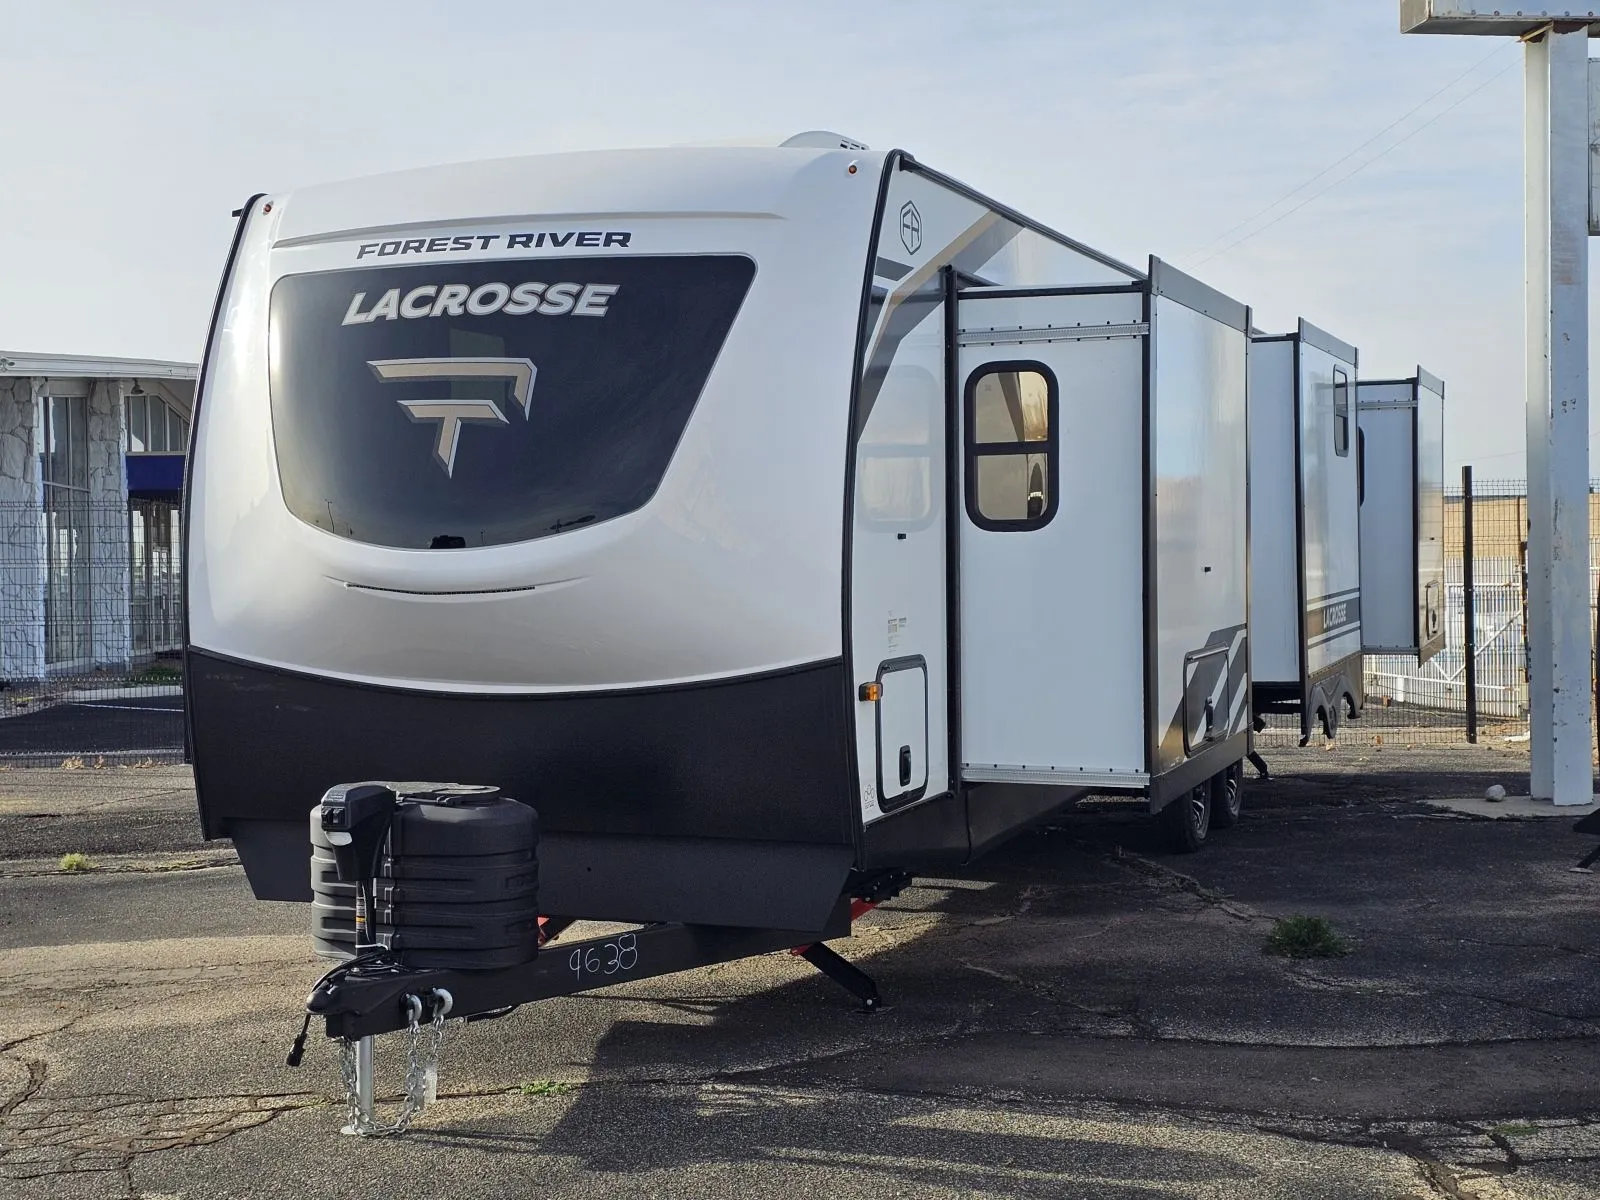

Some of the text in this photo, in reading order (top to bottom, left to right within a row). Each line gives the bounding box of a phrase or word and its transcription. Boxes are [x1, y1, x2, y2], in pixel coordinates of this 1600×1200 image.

[356, 231, 632, 260] FOREST RIVER
[341, 281, 621, 326] LACROSSE
[1323, 602, 1347, 629] LACROSSE
[569, 933, 638, 981] 9638
